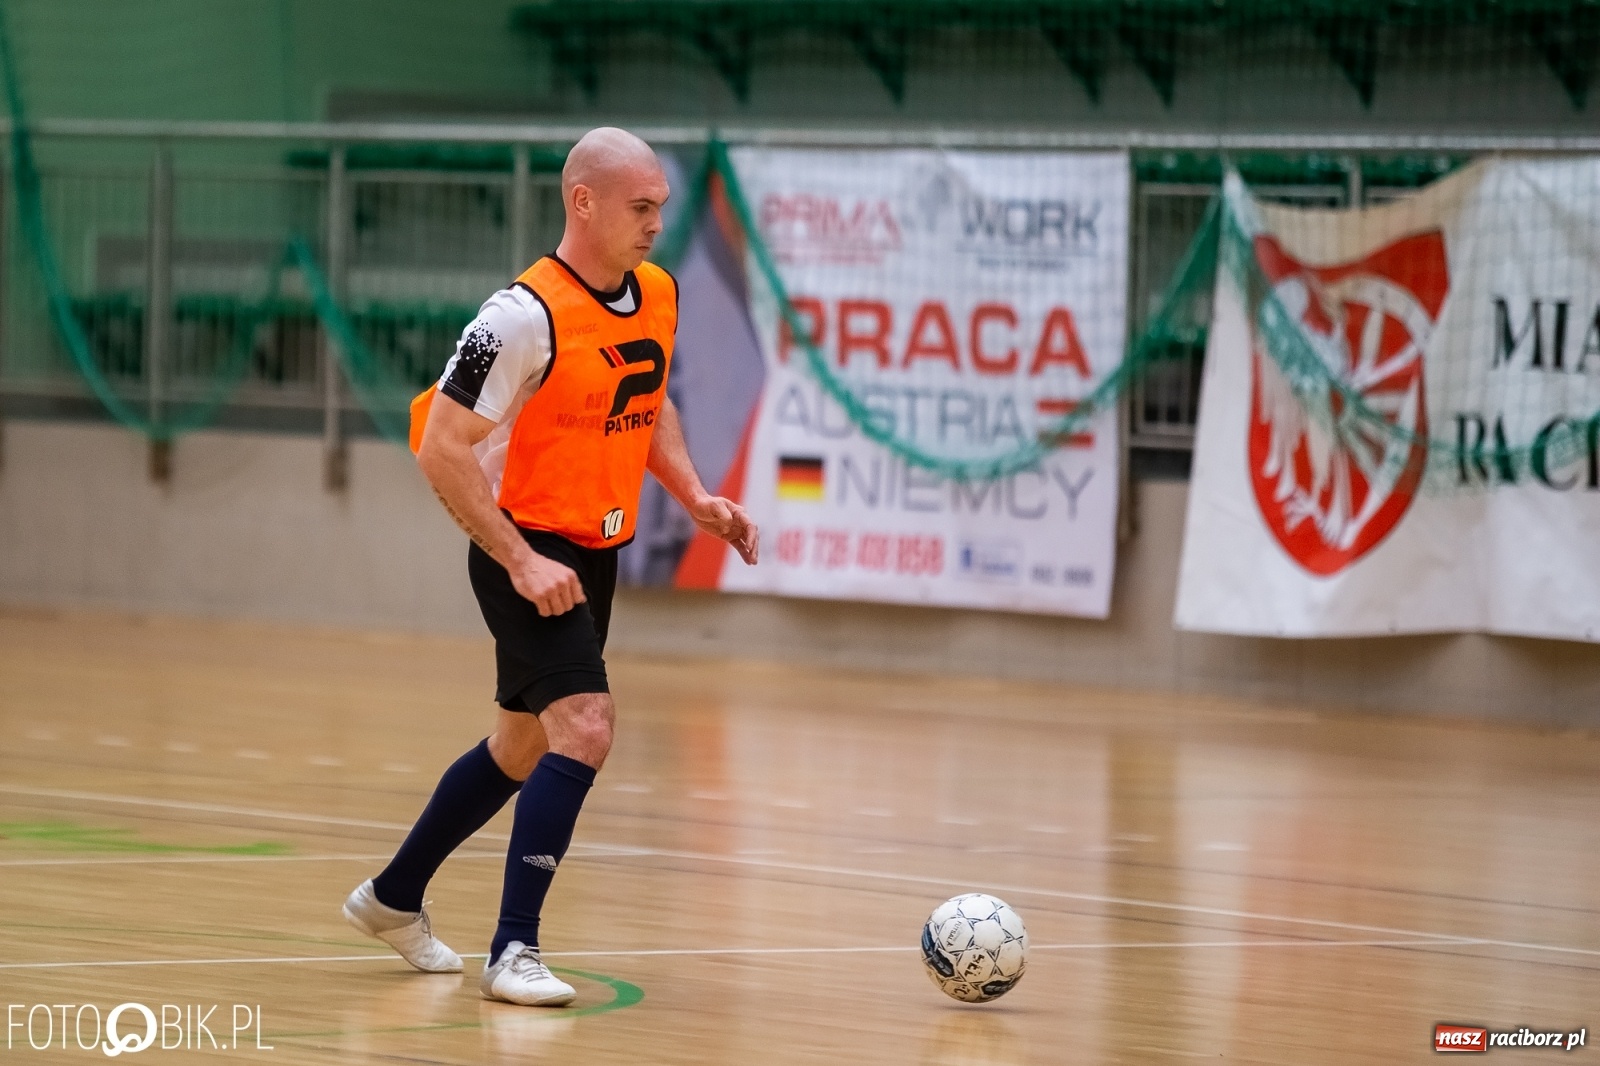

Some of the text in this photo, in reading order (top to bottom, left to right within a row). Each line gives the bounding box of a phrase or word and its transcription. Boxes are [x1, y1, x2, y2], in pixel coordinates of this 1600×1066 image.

[960, 198, 1100, 242] WORK
[777, 298, 1091, 379] PRACA
[604, 406, 659, 437] PATRIC
[776, 383, 1028, 445] AUSTRIA
[839, 455, 1095, 521] NIEMCY
[603, 508, 625, 539] 10
